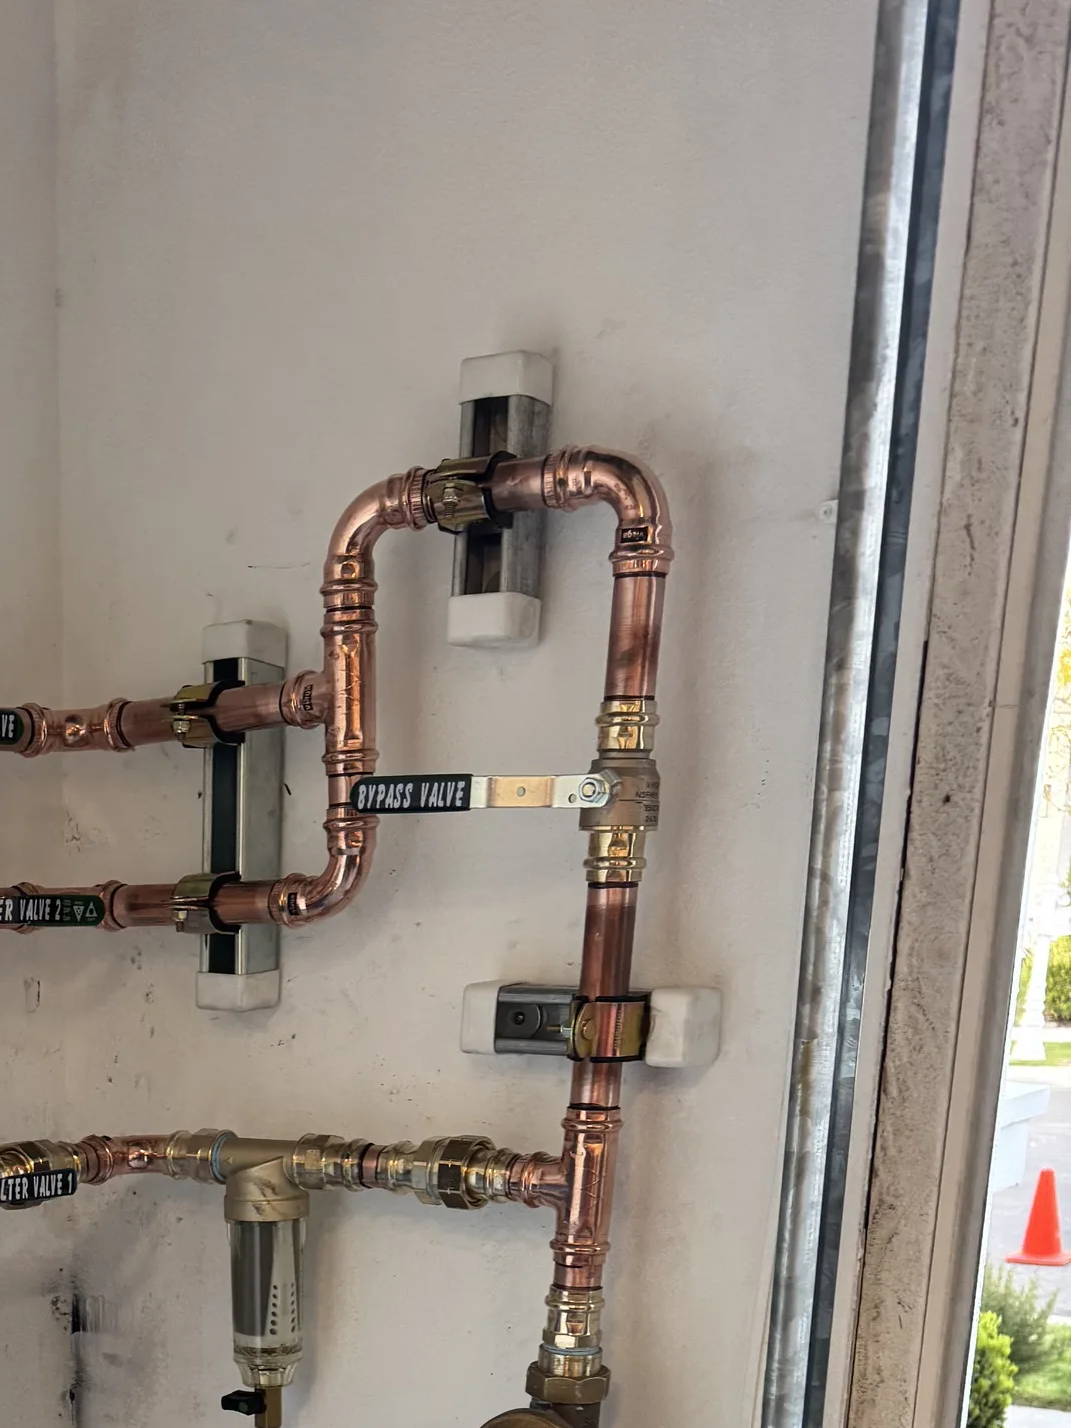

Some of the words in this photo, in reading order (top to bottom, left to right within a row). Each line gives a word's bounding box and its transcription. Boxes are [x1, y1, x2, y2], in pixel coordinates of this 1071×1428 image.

[358, 783, 413, 809] BYPASS
[420, 781, 465, 808] VALVE
[19, 899, 50, 920] VALVE
[55, 899, 62, 920] 2
[33, 1173, 62, 1198] VALVE
[68, 1172, 73, 1194] 1
